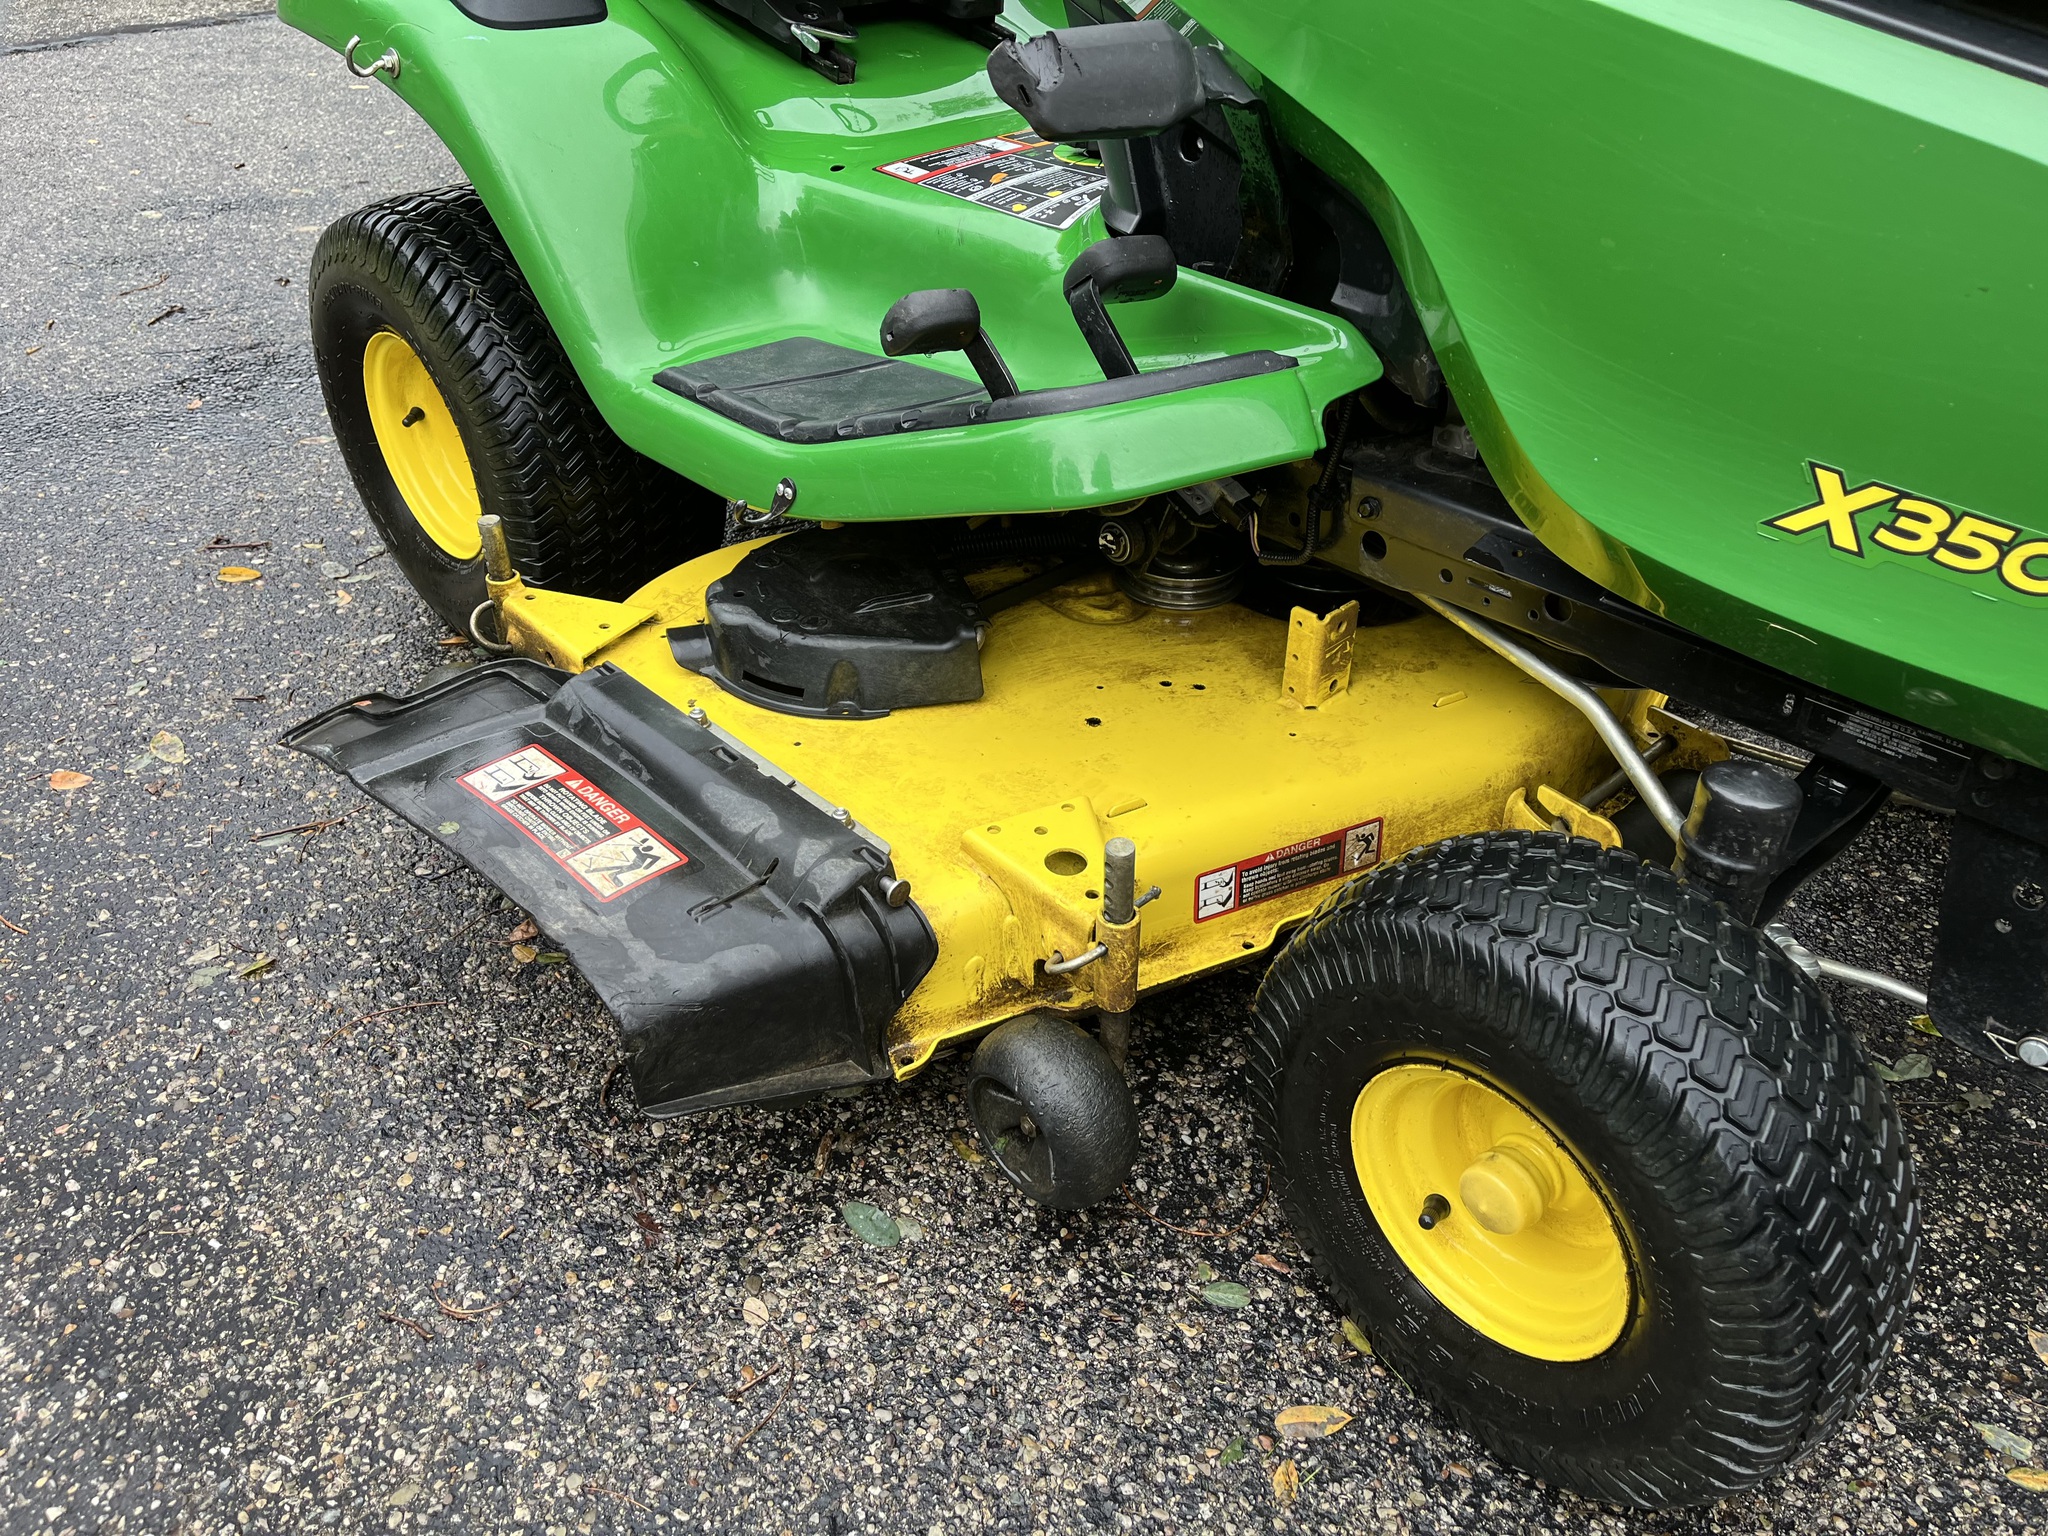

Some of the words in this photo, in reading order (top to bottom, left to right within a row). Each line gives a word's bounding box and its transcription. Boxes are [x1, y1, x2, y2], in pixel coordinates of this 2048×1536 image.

[538, 794, 565, 814] THROWN
[561, 812, 591, 834] OBJECTS
[558, 787, 589, 809] ROTATING
[585, 808, 608, 825] BLADE
[576, 785, 632, 824] DANGER
[1276, 838, 1321, 859] DANGER
[1250, 866, 1262, 875] avoid
